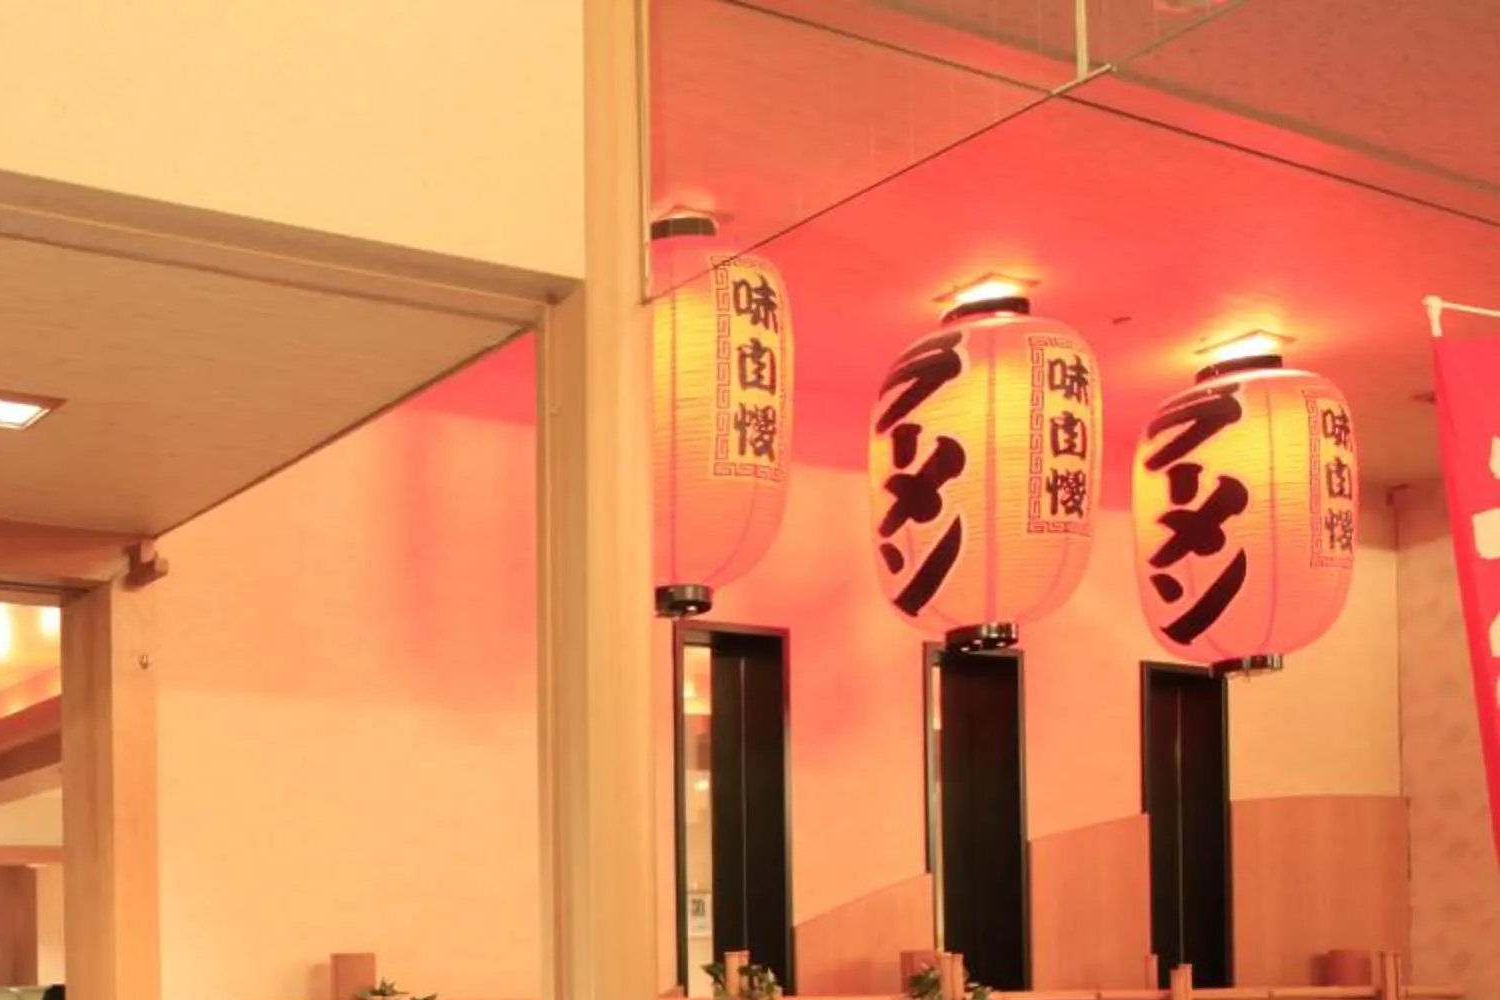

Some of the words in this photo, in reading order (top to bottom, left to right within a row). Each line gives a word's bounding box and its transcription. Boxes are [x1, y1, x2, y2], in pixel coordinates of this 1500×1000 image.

[875, 330, 967, 618] ラーメン
[1144, 382, 1250, 645] ラーメン
